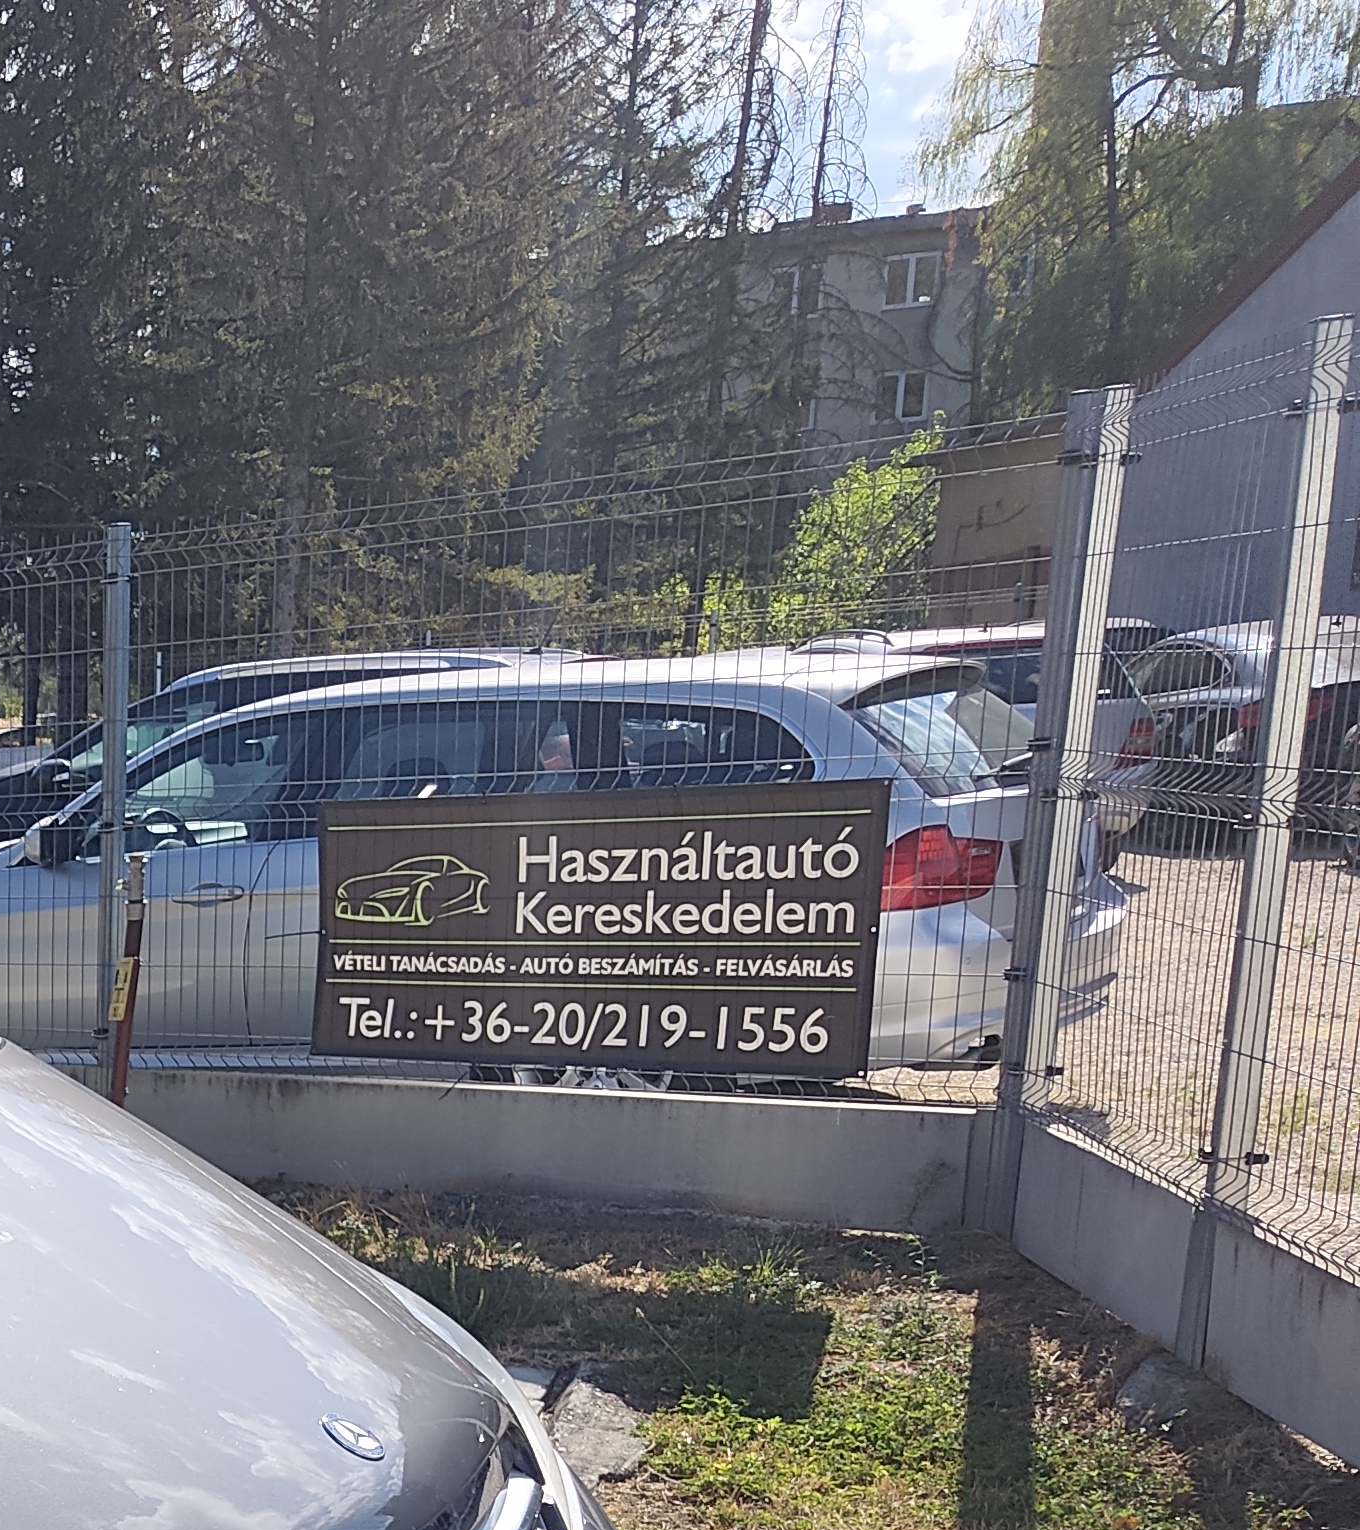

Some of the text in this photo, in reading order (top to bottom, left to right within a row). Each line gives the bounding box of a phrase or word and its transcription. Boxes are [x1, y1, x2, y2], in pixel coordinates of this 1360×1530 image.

[518, 826, 860, 883] Használtautó
[516, 888, 855, 935] Kereskedelem
[333, 951, 386, 973] VÉTELI
[389, 952, 505, 974] TANÁCSADÁS
[520, 954, 574, 975] AUTÓ
[578, 953, 699, 977] BESZÁMÍTÁS
[715, 955, 854, 978] FELVÁSÁRLÁS
